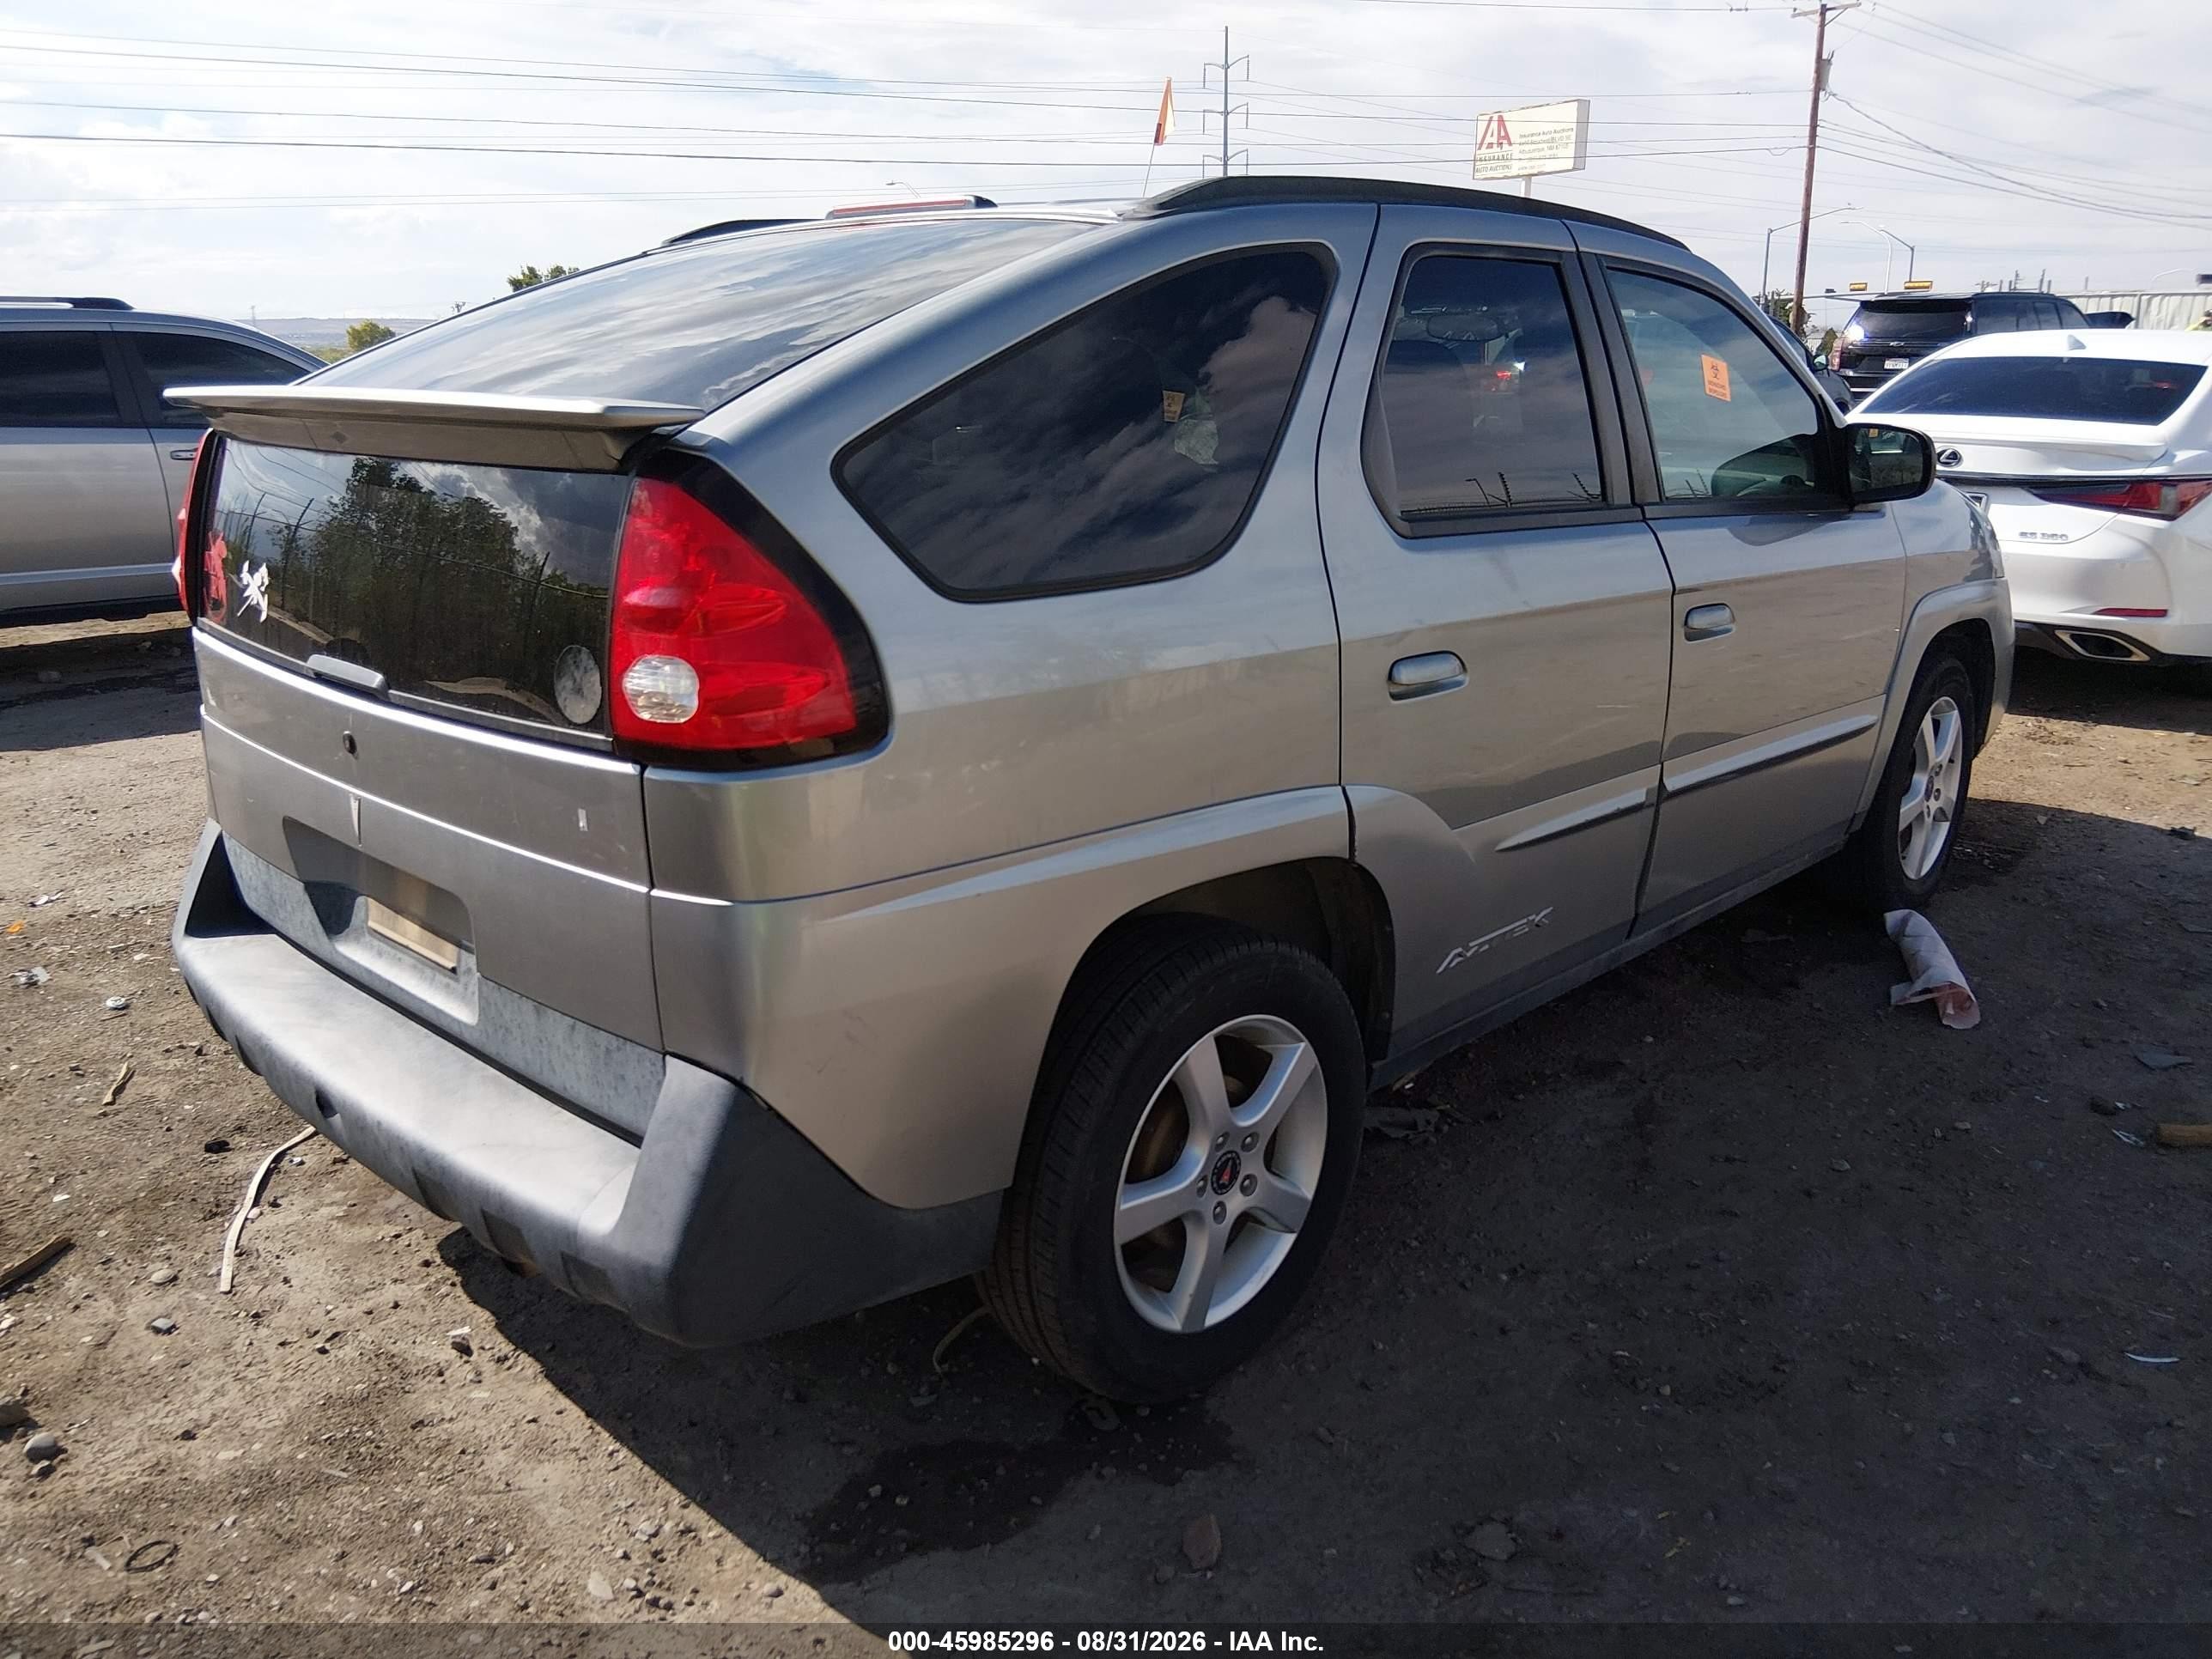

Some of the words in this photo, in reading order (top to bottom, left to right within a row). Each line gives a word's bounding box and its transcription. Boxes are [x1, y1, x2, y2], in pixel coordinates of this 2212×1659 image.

[1476, 152, 1514, 163] INSURANCE
[1475, 164, 1489, 173] AUTO
[1489, 163, 1512, 173] AUCTIONS
